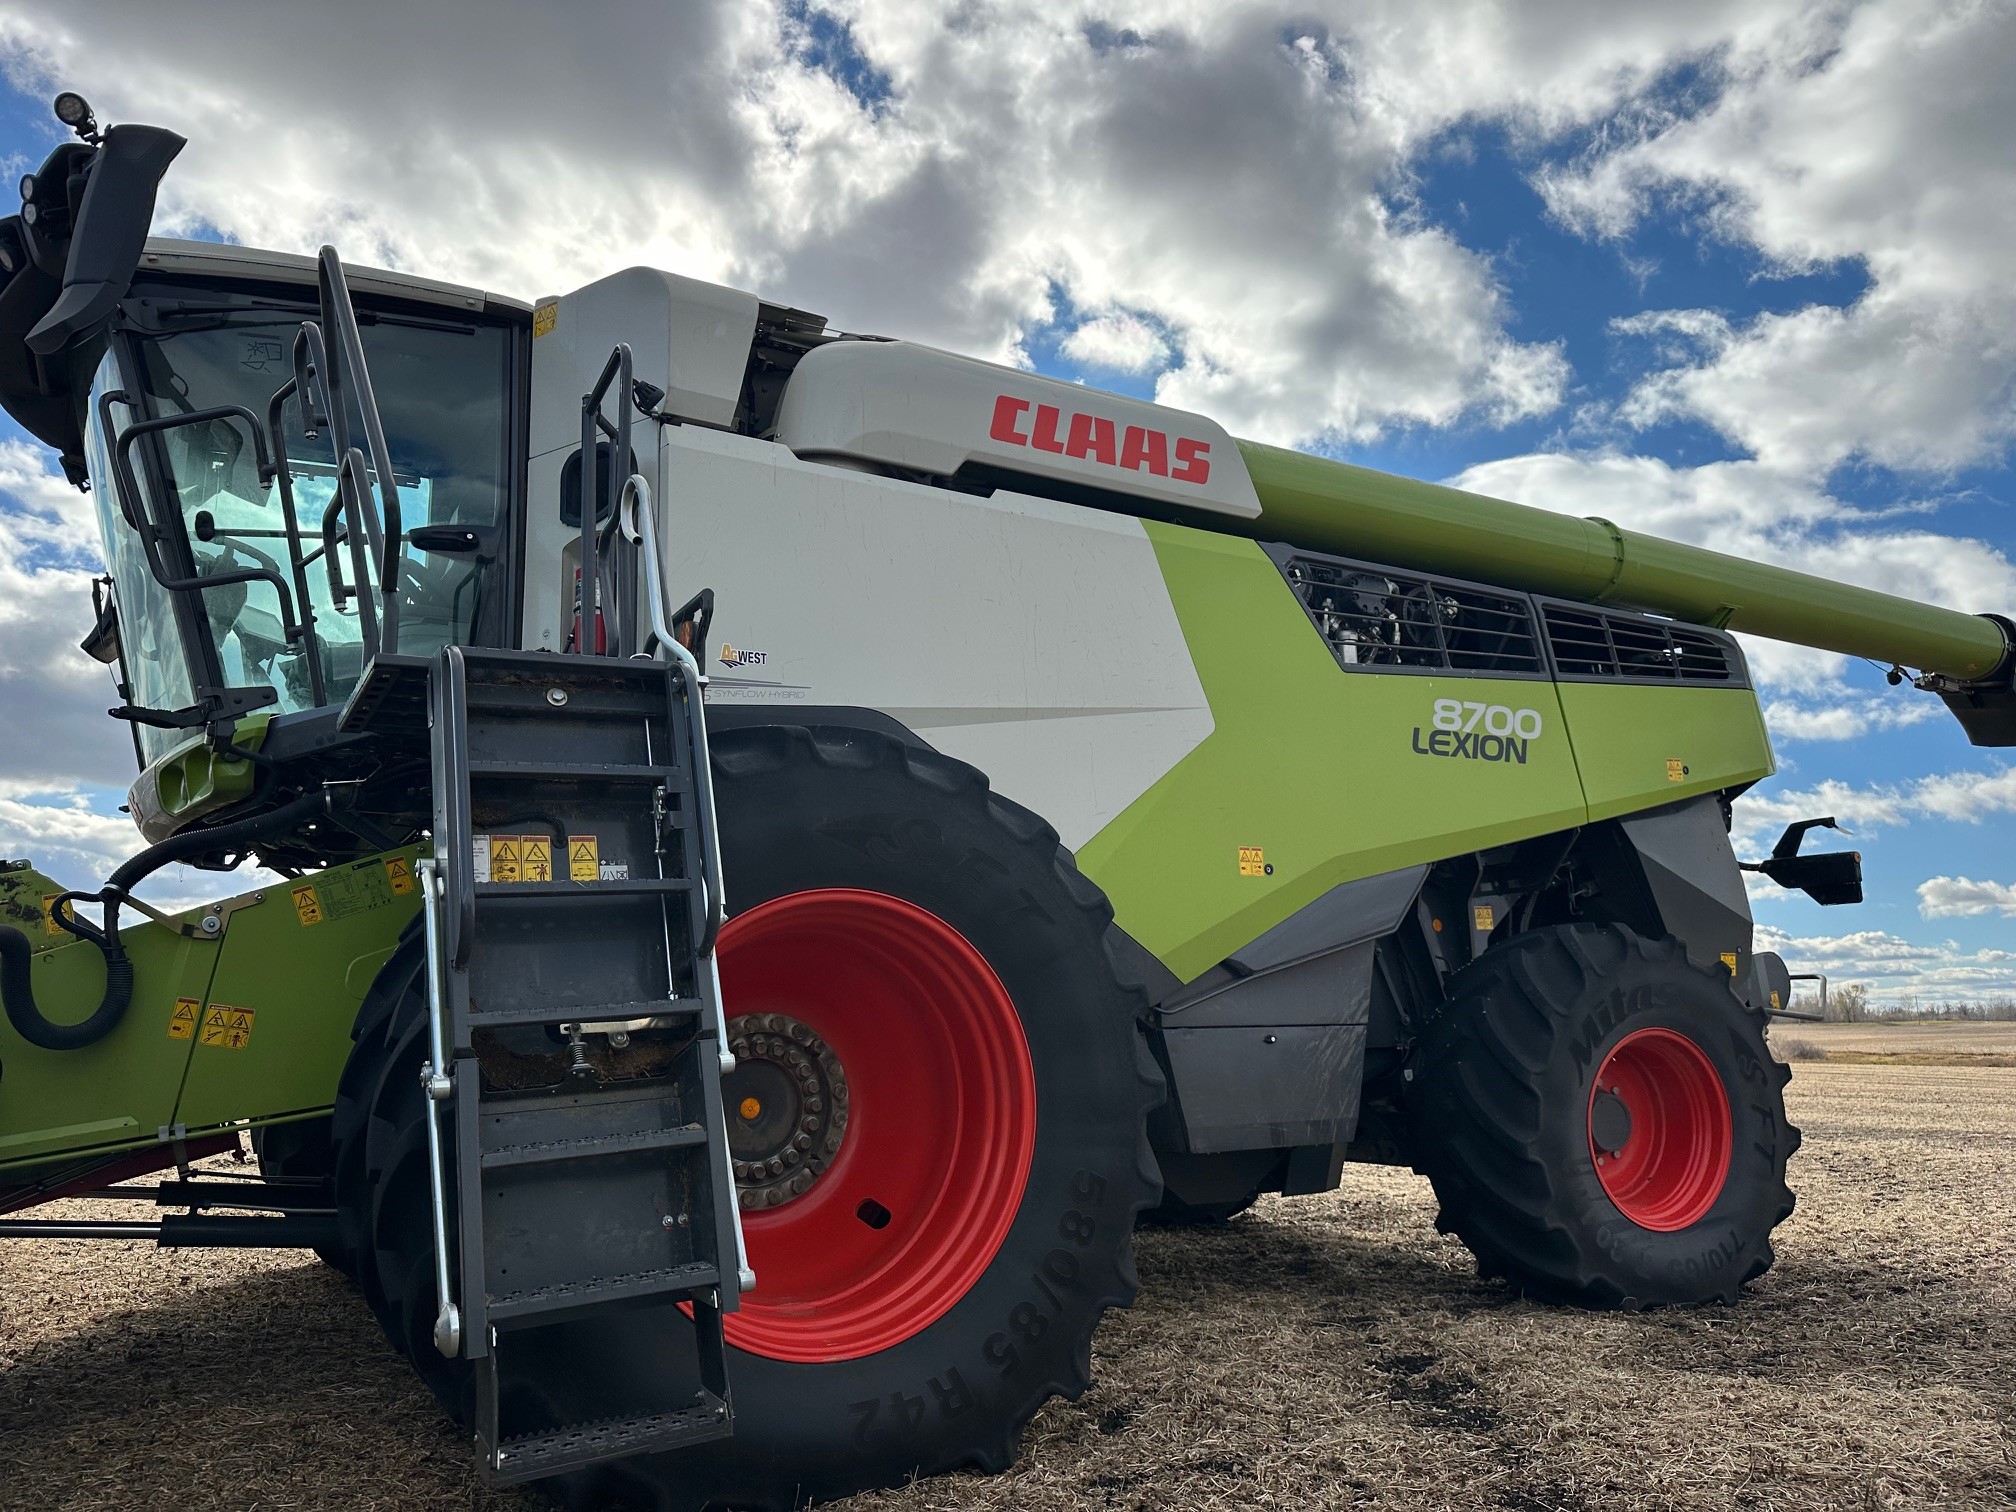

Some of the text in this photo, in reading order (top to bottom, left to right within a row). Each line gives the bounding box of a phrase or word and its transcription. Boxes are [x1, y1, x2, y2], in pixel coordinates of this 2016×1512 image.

[989, 394, 1211, 485] CLAAS
[714, 689, 766, 699] SYNFLOW
[768, 690, 806, 699] HYBRID
[1433, 698, 1543, 740] 8700
[1412, 727, 1528, 764] LEXION
[1568, 983, 1679, 1088] Mitas
[847, 1168, 1109, 1454] 580/85 R42
